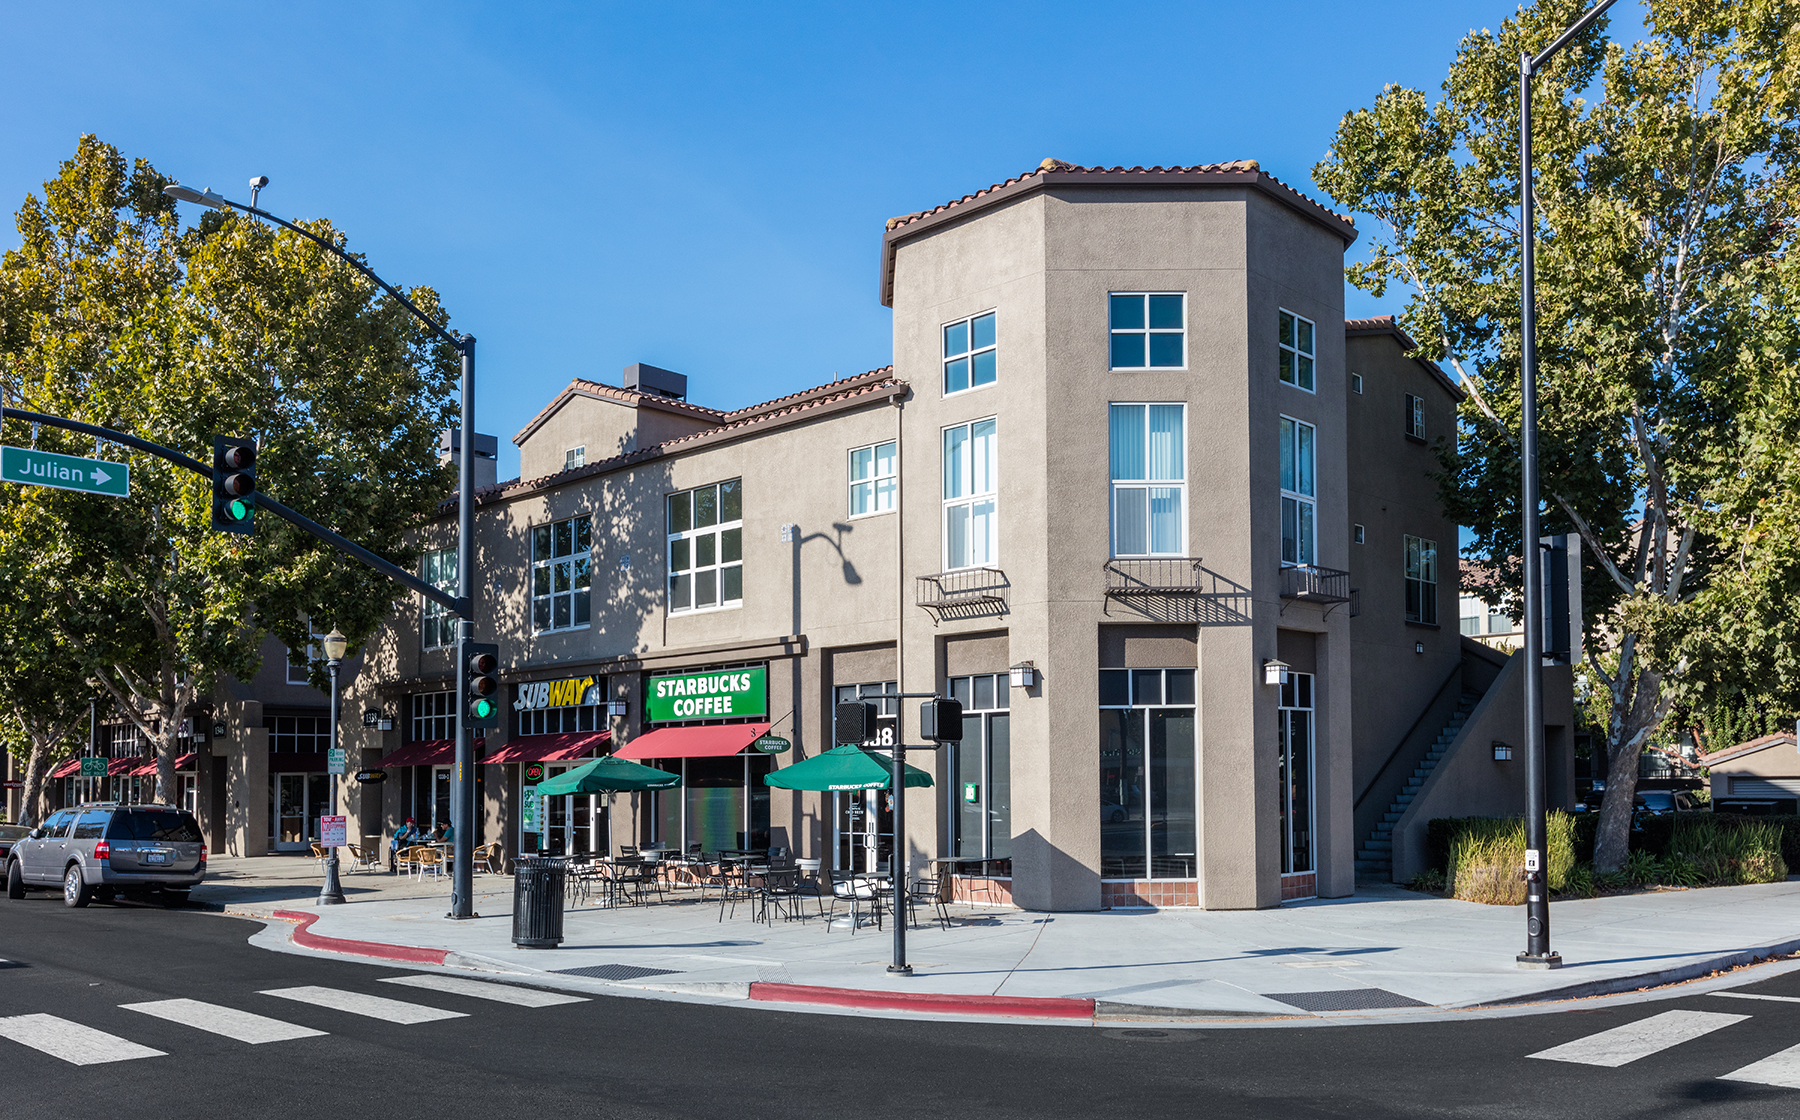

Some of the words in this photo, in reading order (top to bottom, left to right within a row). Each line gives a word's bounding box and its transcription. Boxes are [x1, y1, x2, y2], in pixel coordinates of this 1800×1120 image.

[19, 458, 83, 482] Julian
[513, 675, 593, 711] SUBWAY
[656, 673, 750, 698] STARBUCKS
[673, 696, 732, 716] COFFEE
[528, 768, 541, 776] OPEN
